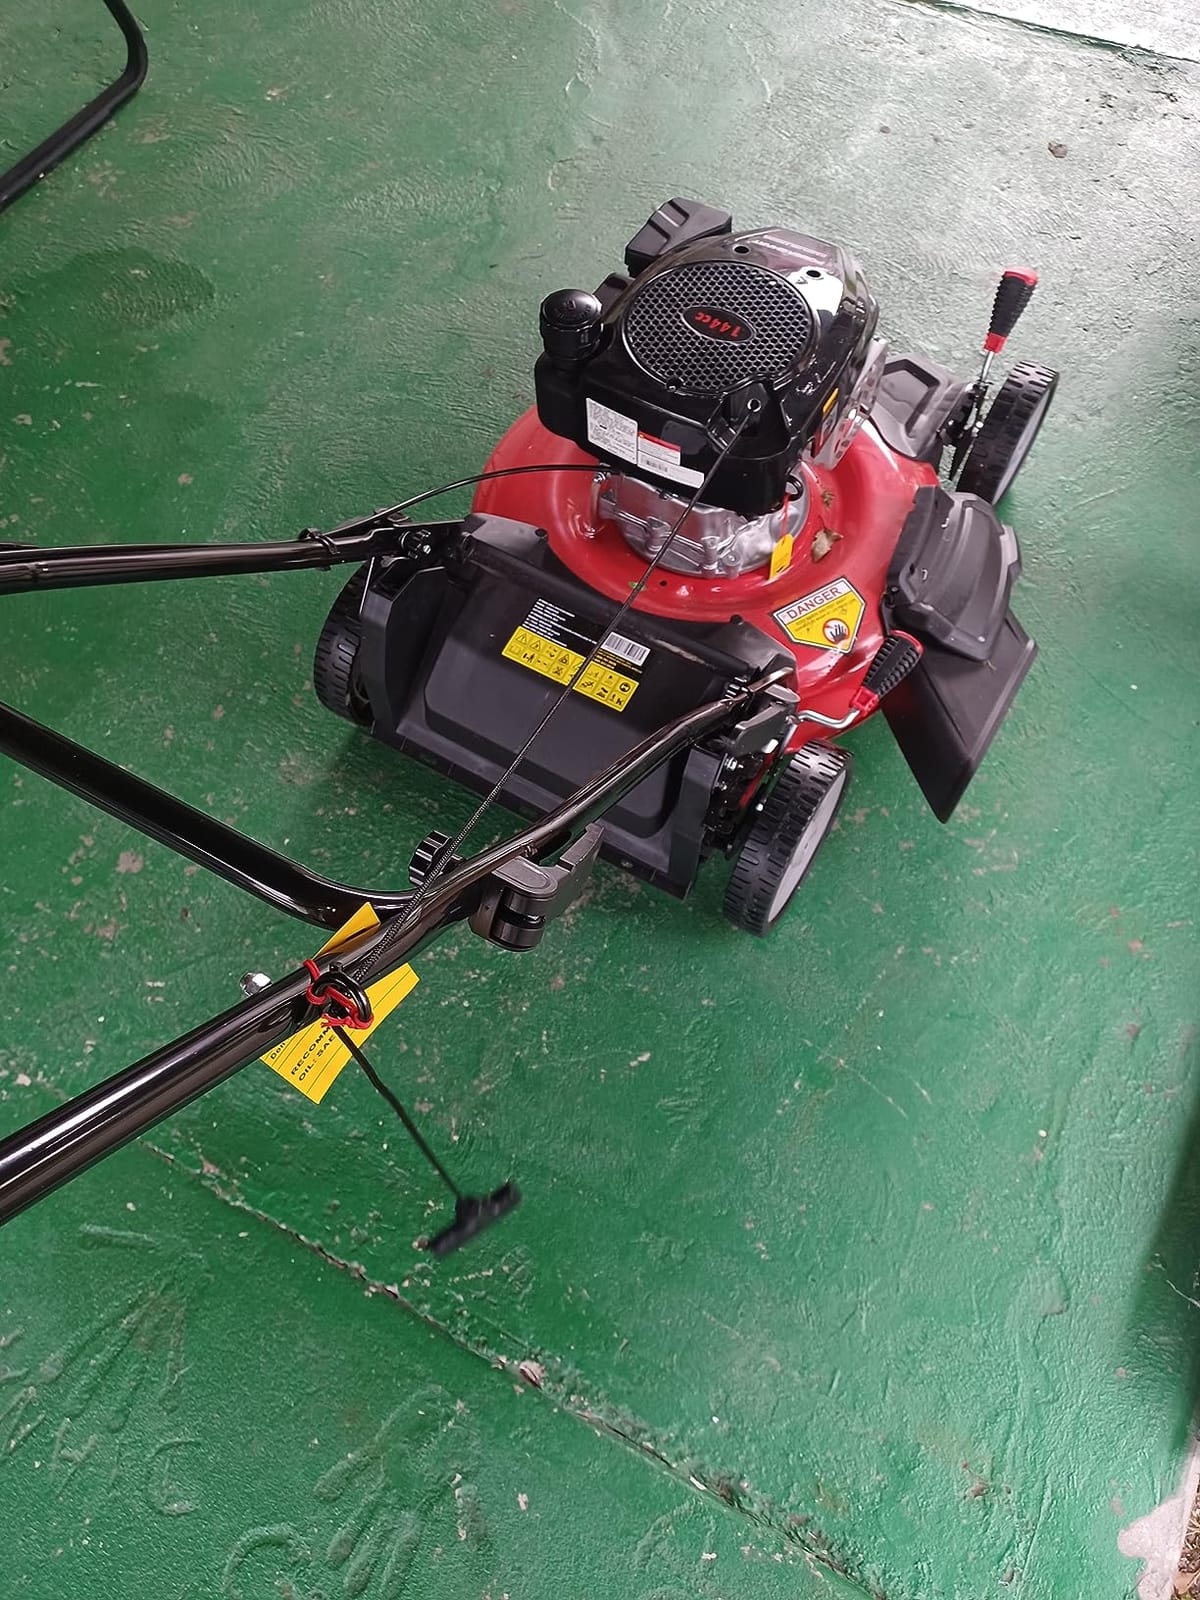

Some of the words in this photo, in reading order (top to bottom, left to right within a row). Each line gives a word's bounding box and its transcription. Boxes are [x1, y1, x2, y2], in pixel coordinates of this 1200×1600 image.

[694, 311, 742, 337] 144cc
[786, 587, 842, 619] DANGER
[299, 1059, 317, 1081] OIL:
[316, 1034, 336, 1057] SAE
